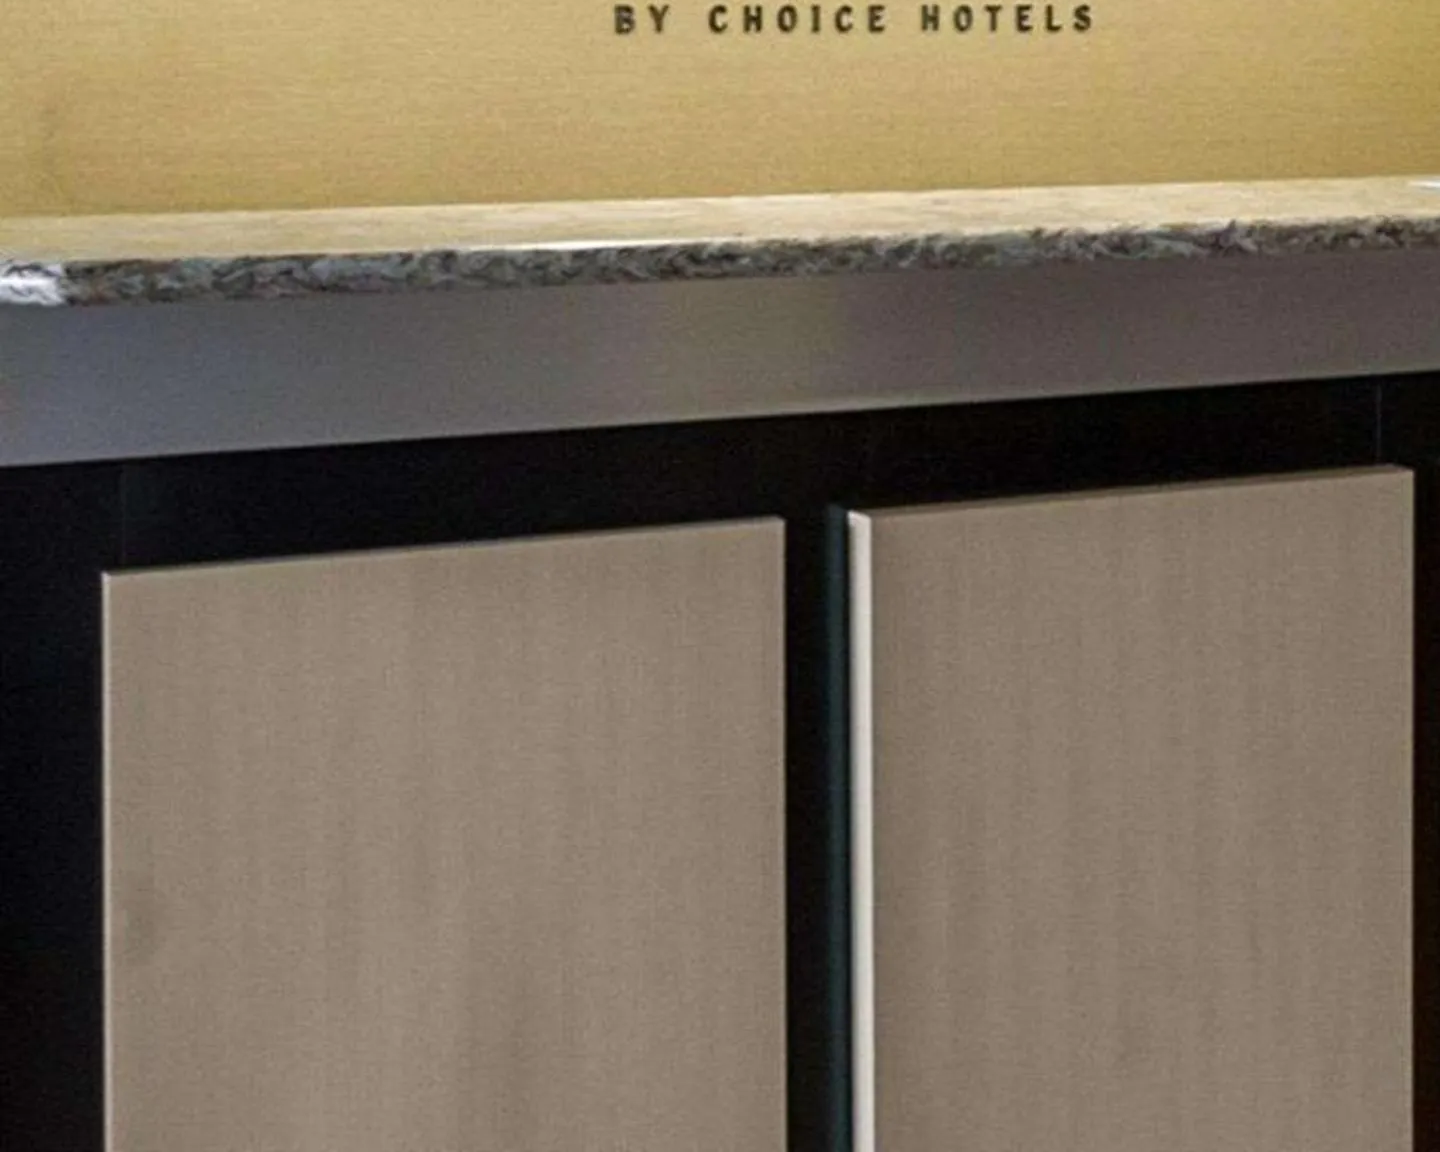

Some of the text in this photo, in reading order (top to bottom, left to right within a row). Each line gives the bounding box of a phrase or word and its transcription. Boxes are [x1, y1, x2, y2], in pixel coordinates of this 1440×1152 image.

[614, 4, 1093, 33] BY CHOICE HOTELS
